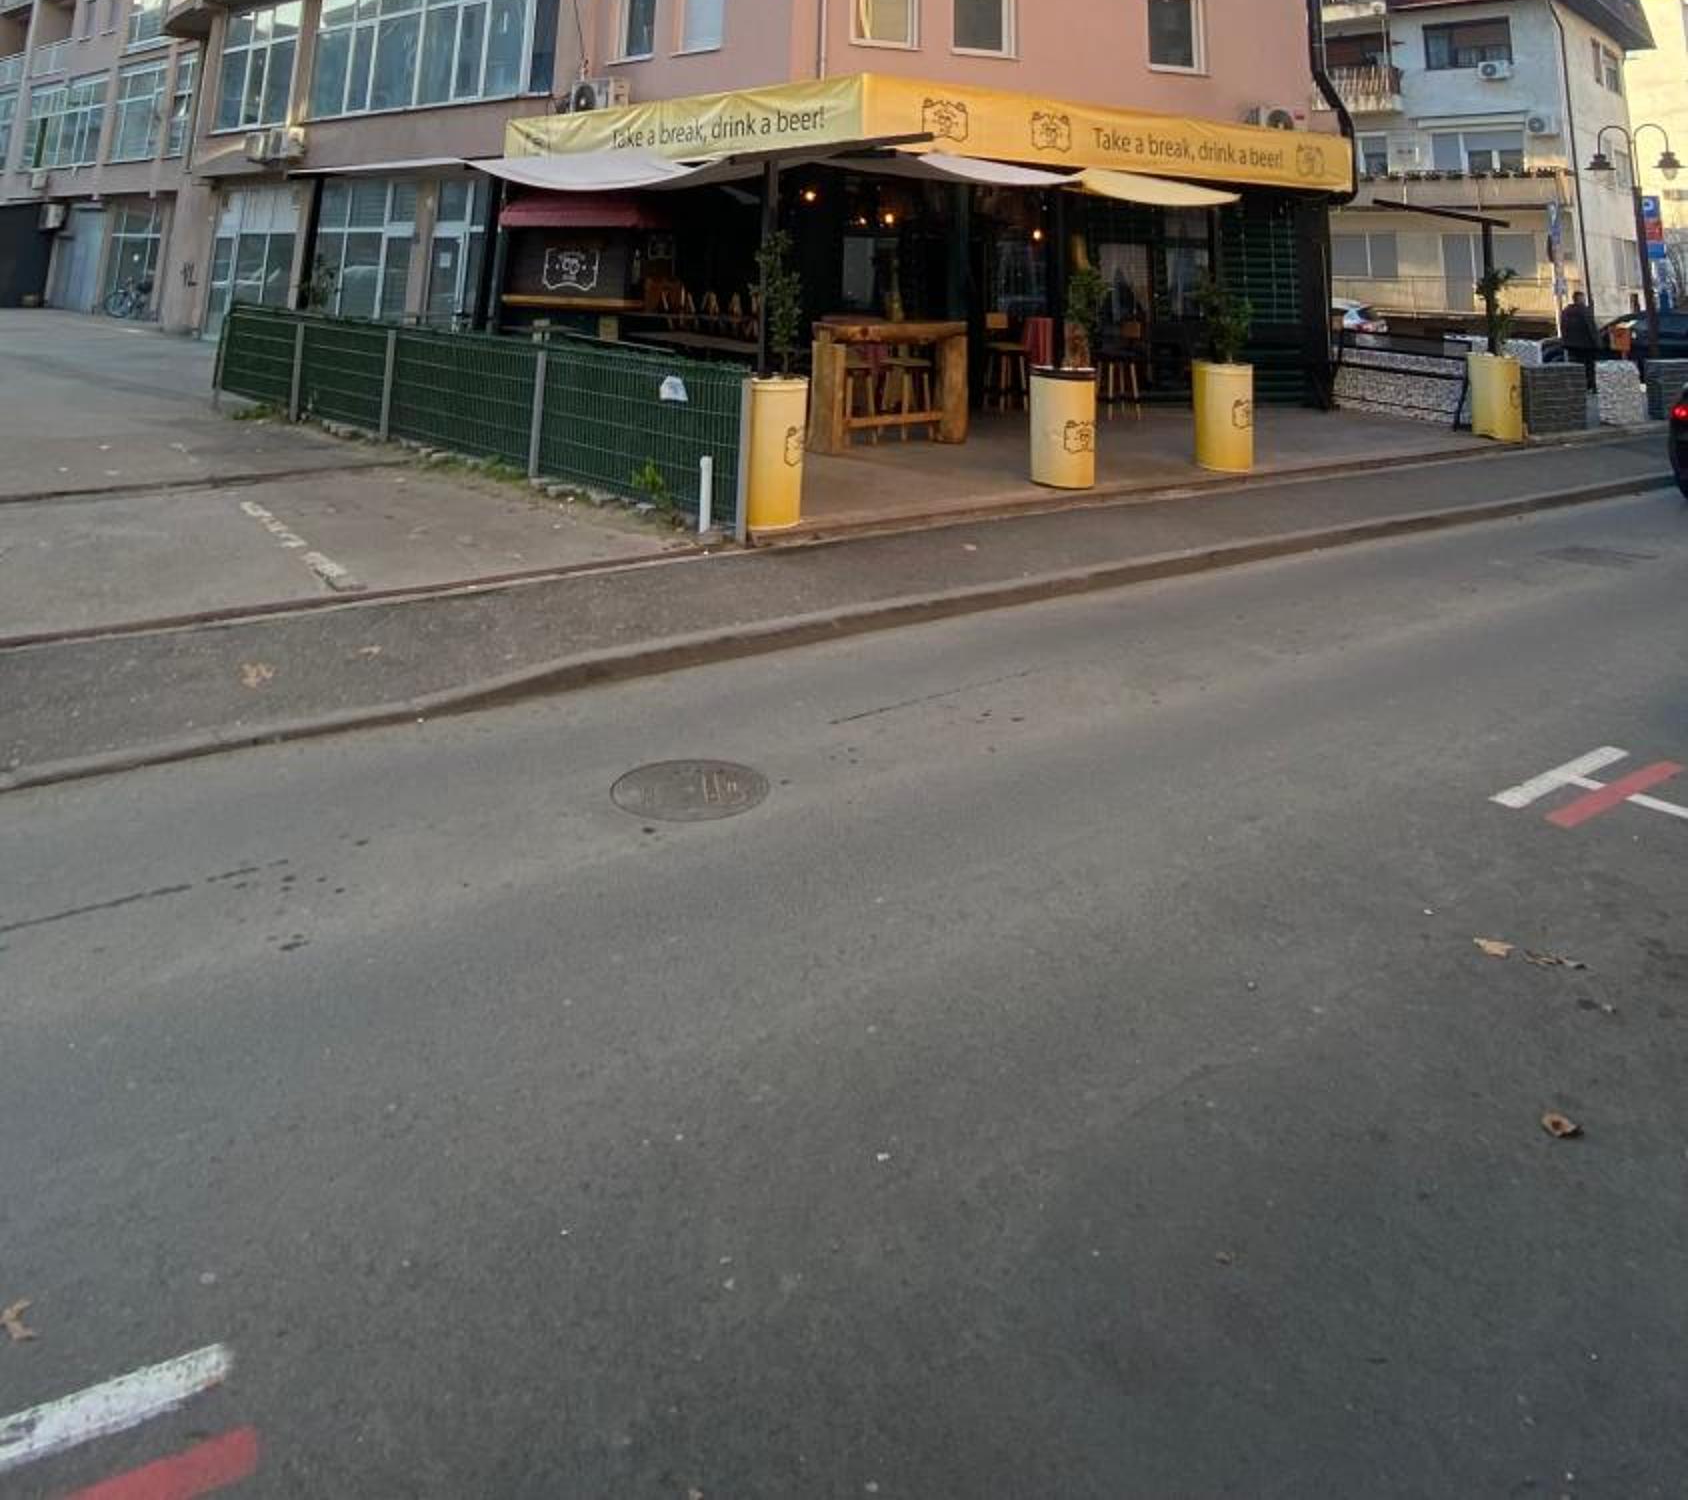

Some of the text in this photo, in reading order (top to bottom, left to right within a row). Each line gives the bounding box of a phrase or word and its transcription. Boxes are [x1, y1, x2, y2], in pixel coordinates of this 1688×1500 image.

[612, 106, 825, 149] Take a break, drink a beer!
[1093, 127, 1131, 152] Take
[1136, 137, 1144, 153] a
[1148, 133, 1195, 162] break,
[1200, 141, 1238, 164] drink
[1240, 149, 1247, 165] a
[1249, 149, 1283, 169] beer!
